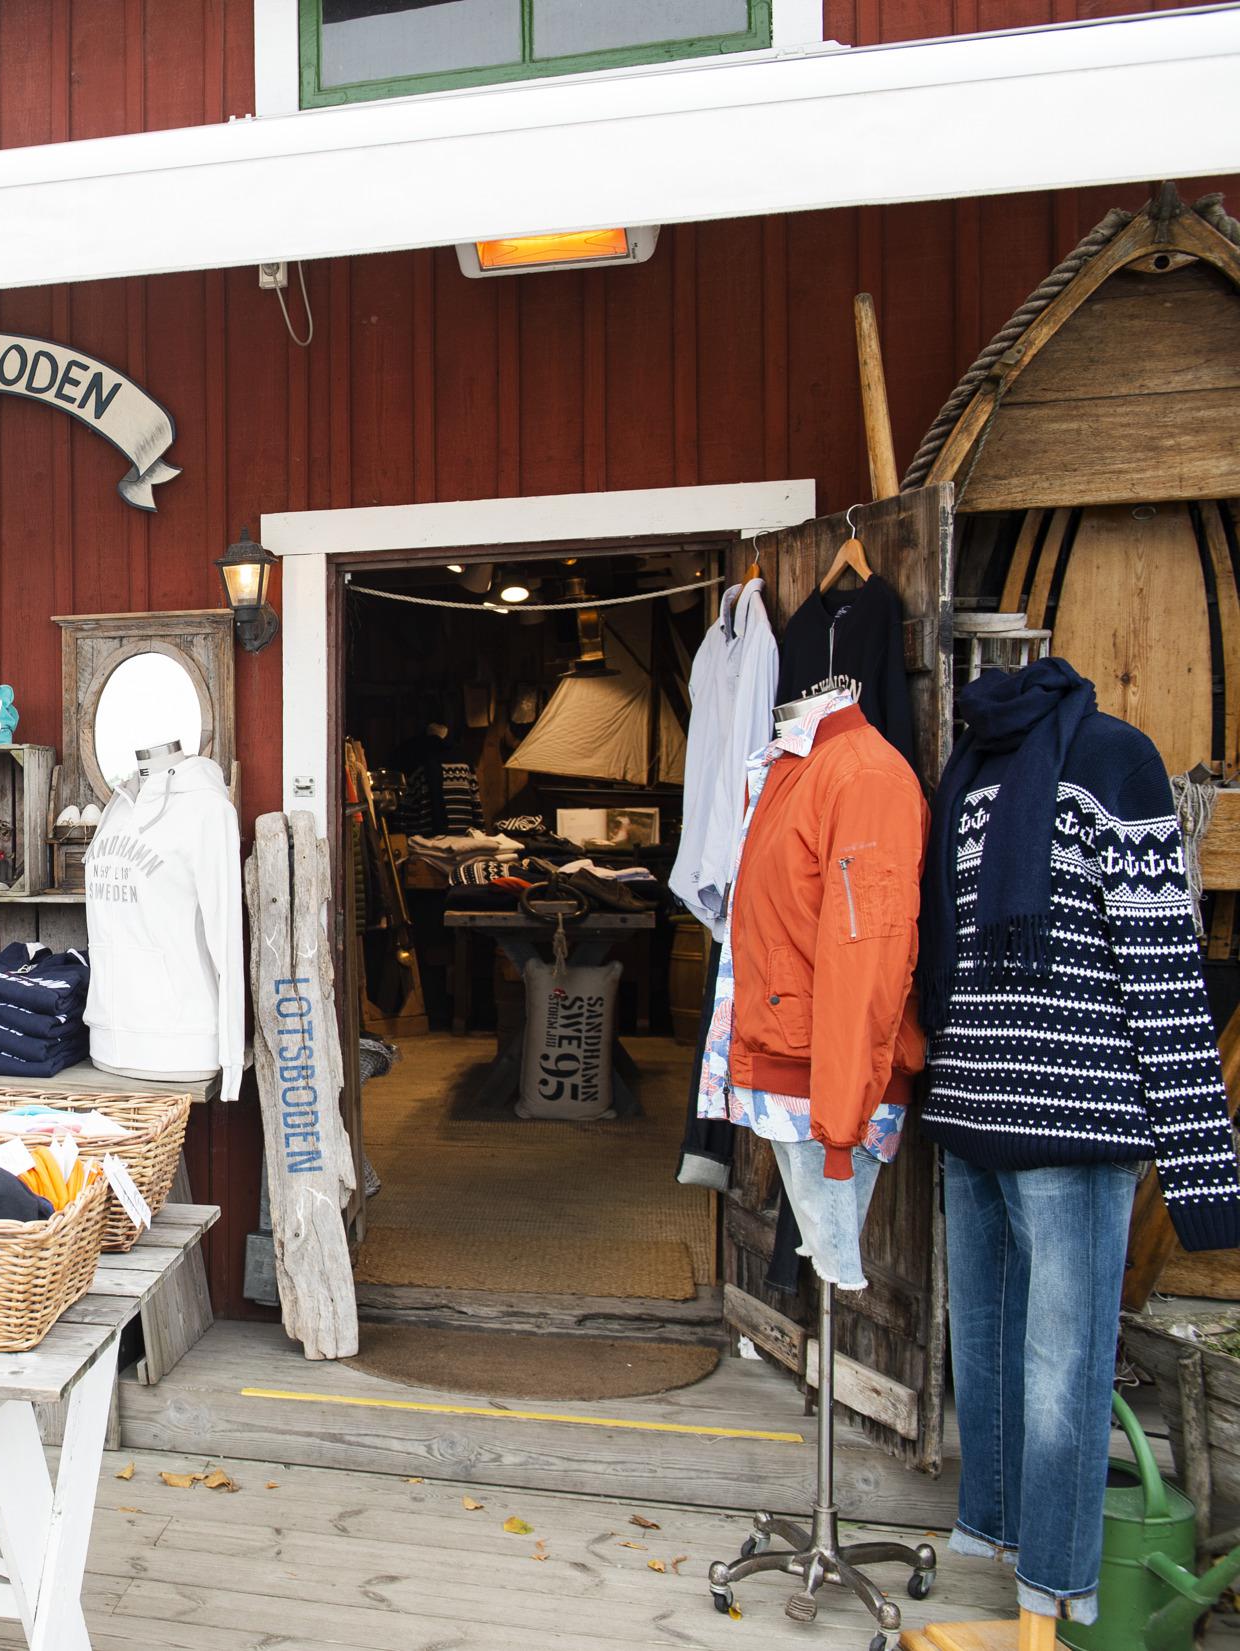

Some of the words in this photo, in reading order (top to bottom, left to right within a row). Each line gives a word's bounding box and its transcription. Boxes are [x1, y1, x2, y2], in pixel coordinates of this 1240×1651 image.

[86, 835, 165, 879] ANDHAMN
[88, 882, 139, 904] SWEDEN
[547, 994, 560, 1031] STORM
[557, 995, 584, 1049] SWE
[581, 994, 604, 1103] SANDHAMN
[273, 976, 323, 1175] LOTSBODEN
[538, 1052, 581, 1102] 95
